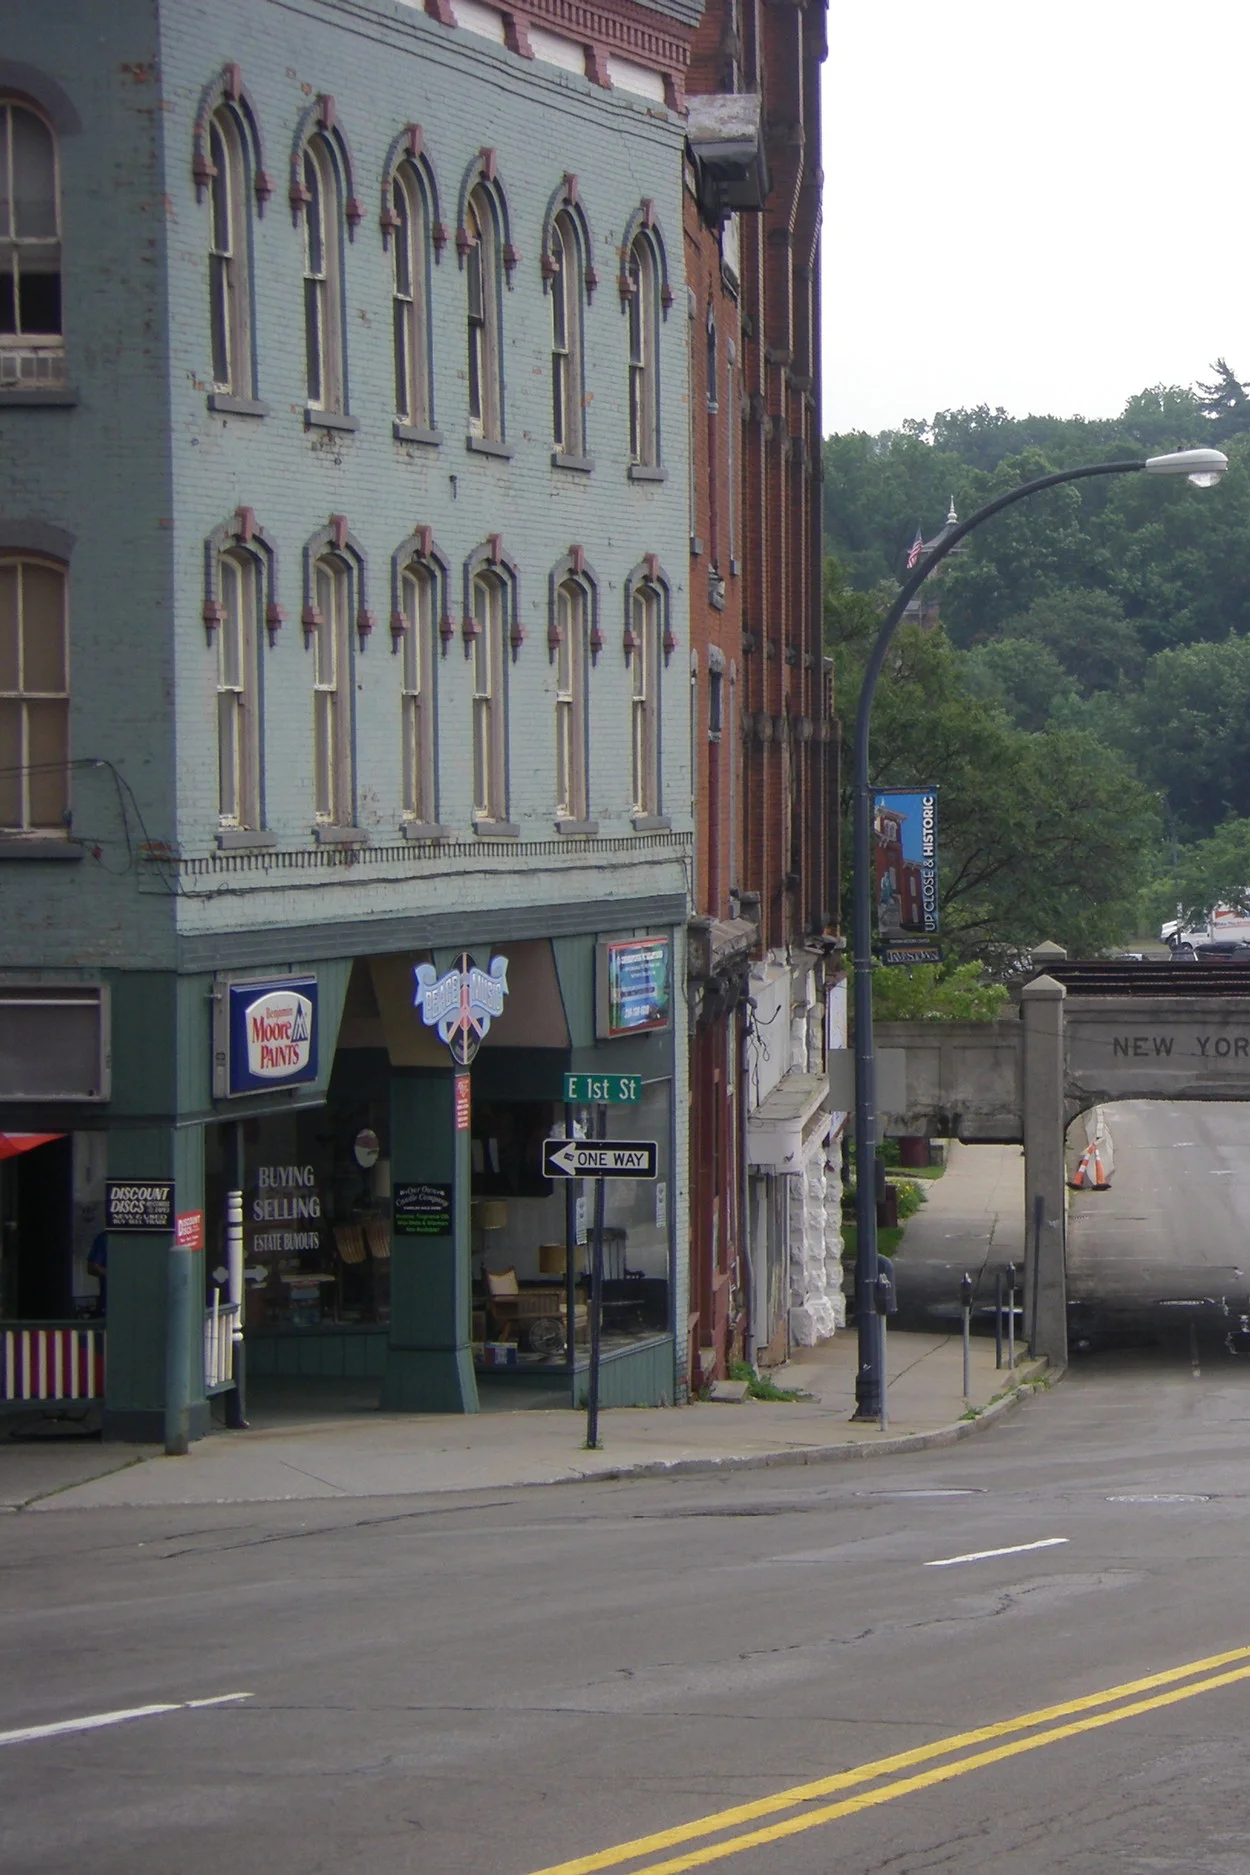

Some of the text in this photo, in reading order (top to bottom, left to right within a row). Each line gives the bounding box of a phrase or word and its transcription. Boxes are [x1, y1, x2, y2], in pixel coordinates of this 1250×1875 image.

[922, 796, 936, 931] UP CLOSE & HISTORIC
[425, 975, 458, 1018] PEACE
[472, 973, 501, 1011] MUSIC
[252, 1016, 292, 1043] Moore
[260, 1044, 299, 1069] PAINTS
[1113, 1036, 1174, 1057] NEW
[568, 1077, 636, 1100] E 1st St
[577, 1152, 608, 1166] ONE
[613, 1152, 644, 1167] WAY
[259, 1165, 315, 1188] BUYING
[111, 1187, 170, 1200] DISCOUNT
[110, 1200, 146, 1213] DISCS
[253, 1197, 320, 1221] SELLING
[254, 1231, 319, 1252] ESTATE BUYOUTS
